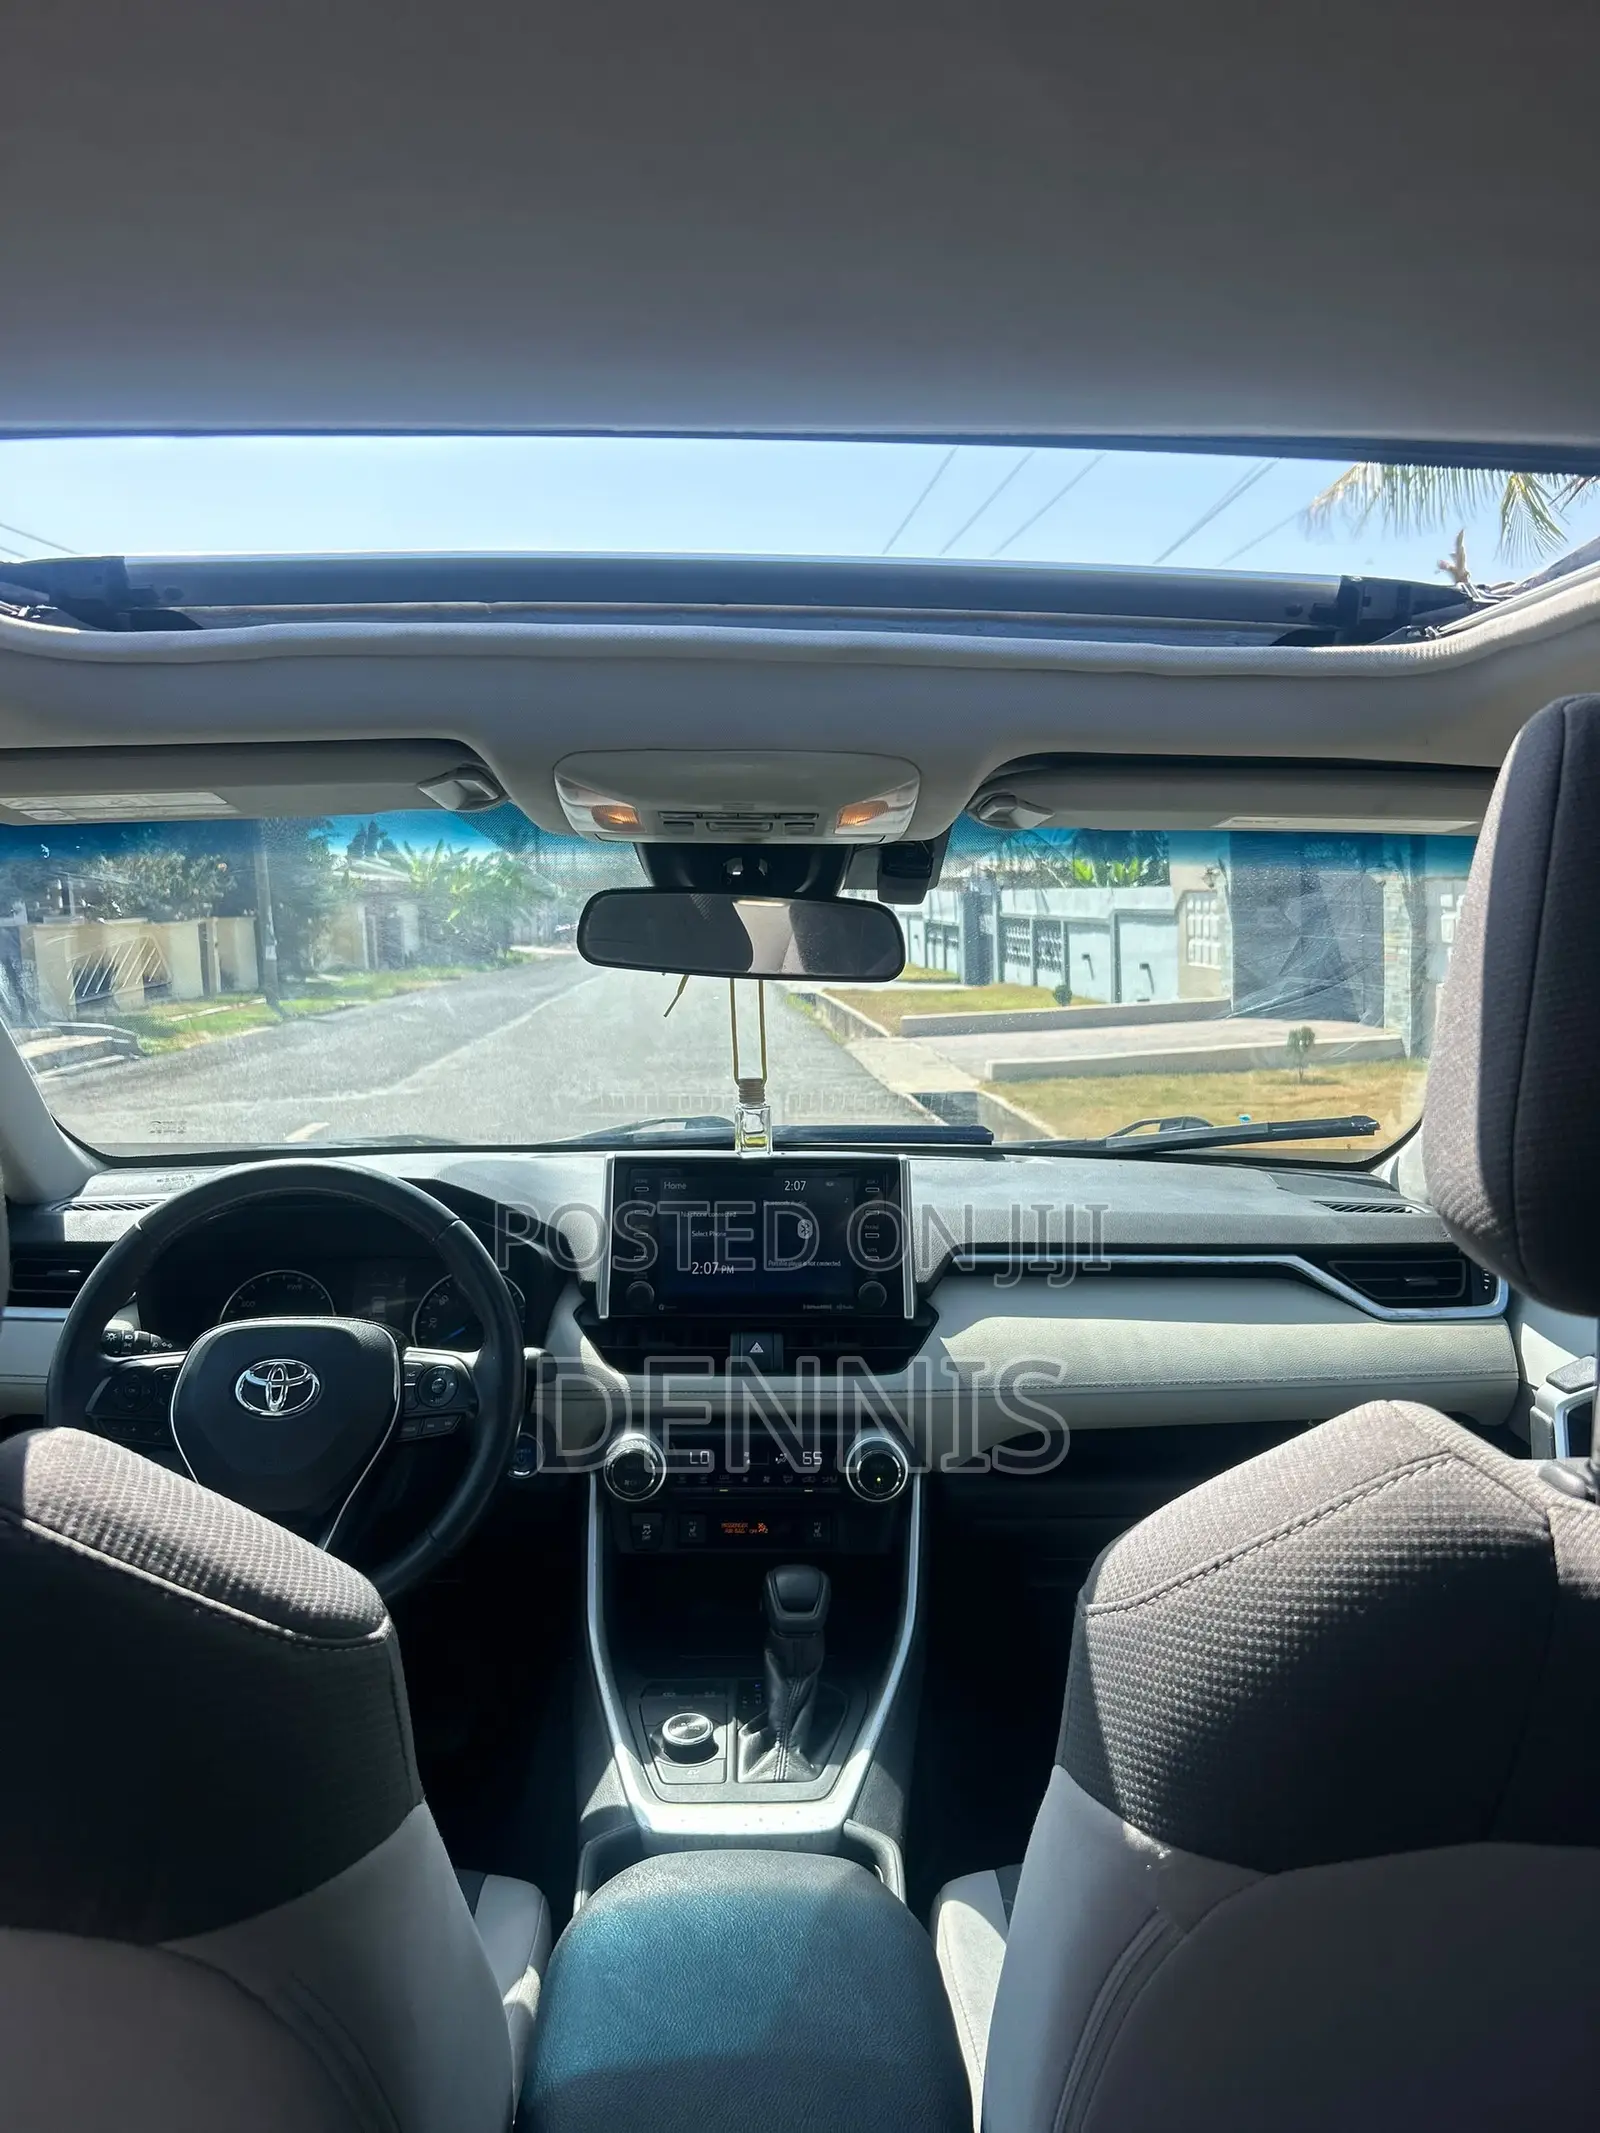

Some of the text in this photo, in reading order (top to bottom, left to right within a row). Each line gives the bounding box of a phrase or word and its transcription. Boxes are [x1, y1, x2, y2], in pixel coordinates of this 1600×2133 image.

[663, 1181, 687, 1191] Home
[784, 1180, 807, 1191] 2:07
[691, 1261, 735, 1275] 2:07 PM
[689, 1450, 710, 1465] LO
[802, 1451, 823, 1465] 65
